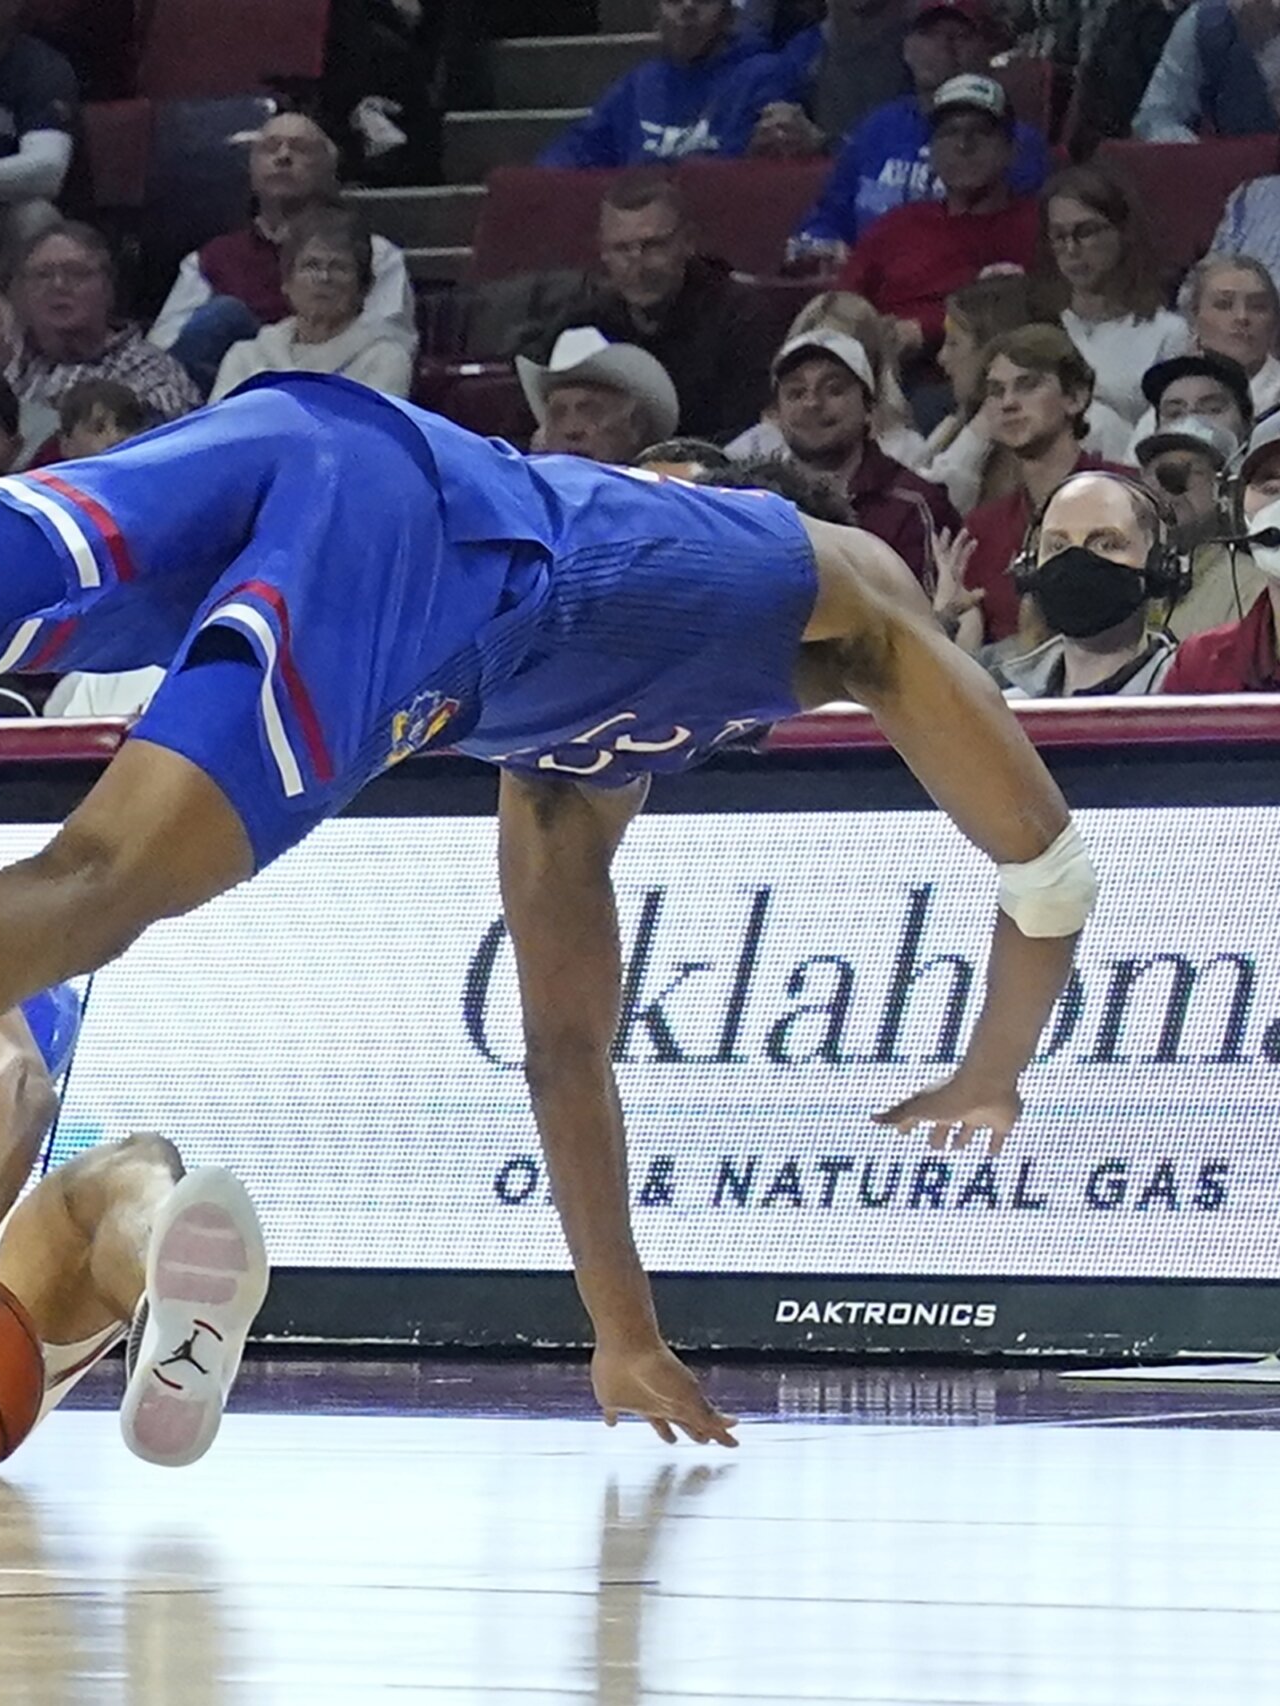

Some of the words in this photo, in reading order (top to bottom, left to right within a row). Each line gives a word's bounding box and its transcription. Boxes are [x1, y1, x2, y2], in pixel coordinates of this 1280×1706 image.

[634, 1154, 676, 1208] &
[710, 1154, 1049, 1211] NATURAL
[1083, 1156, 1228, 1212] GAS
[775, 1300, 997, 1327] DAKTRONICS
